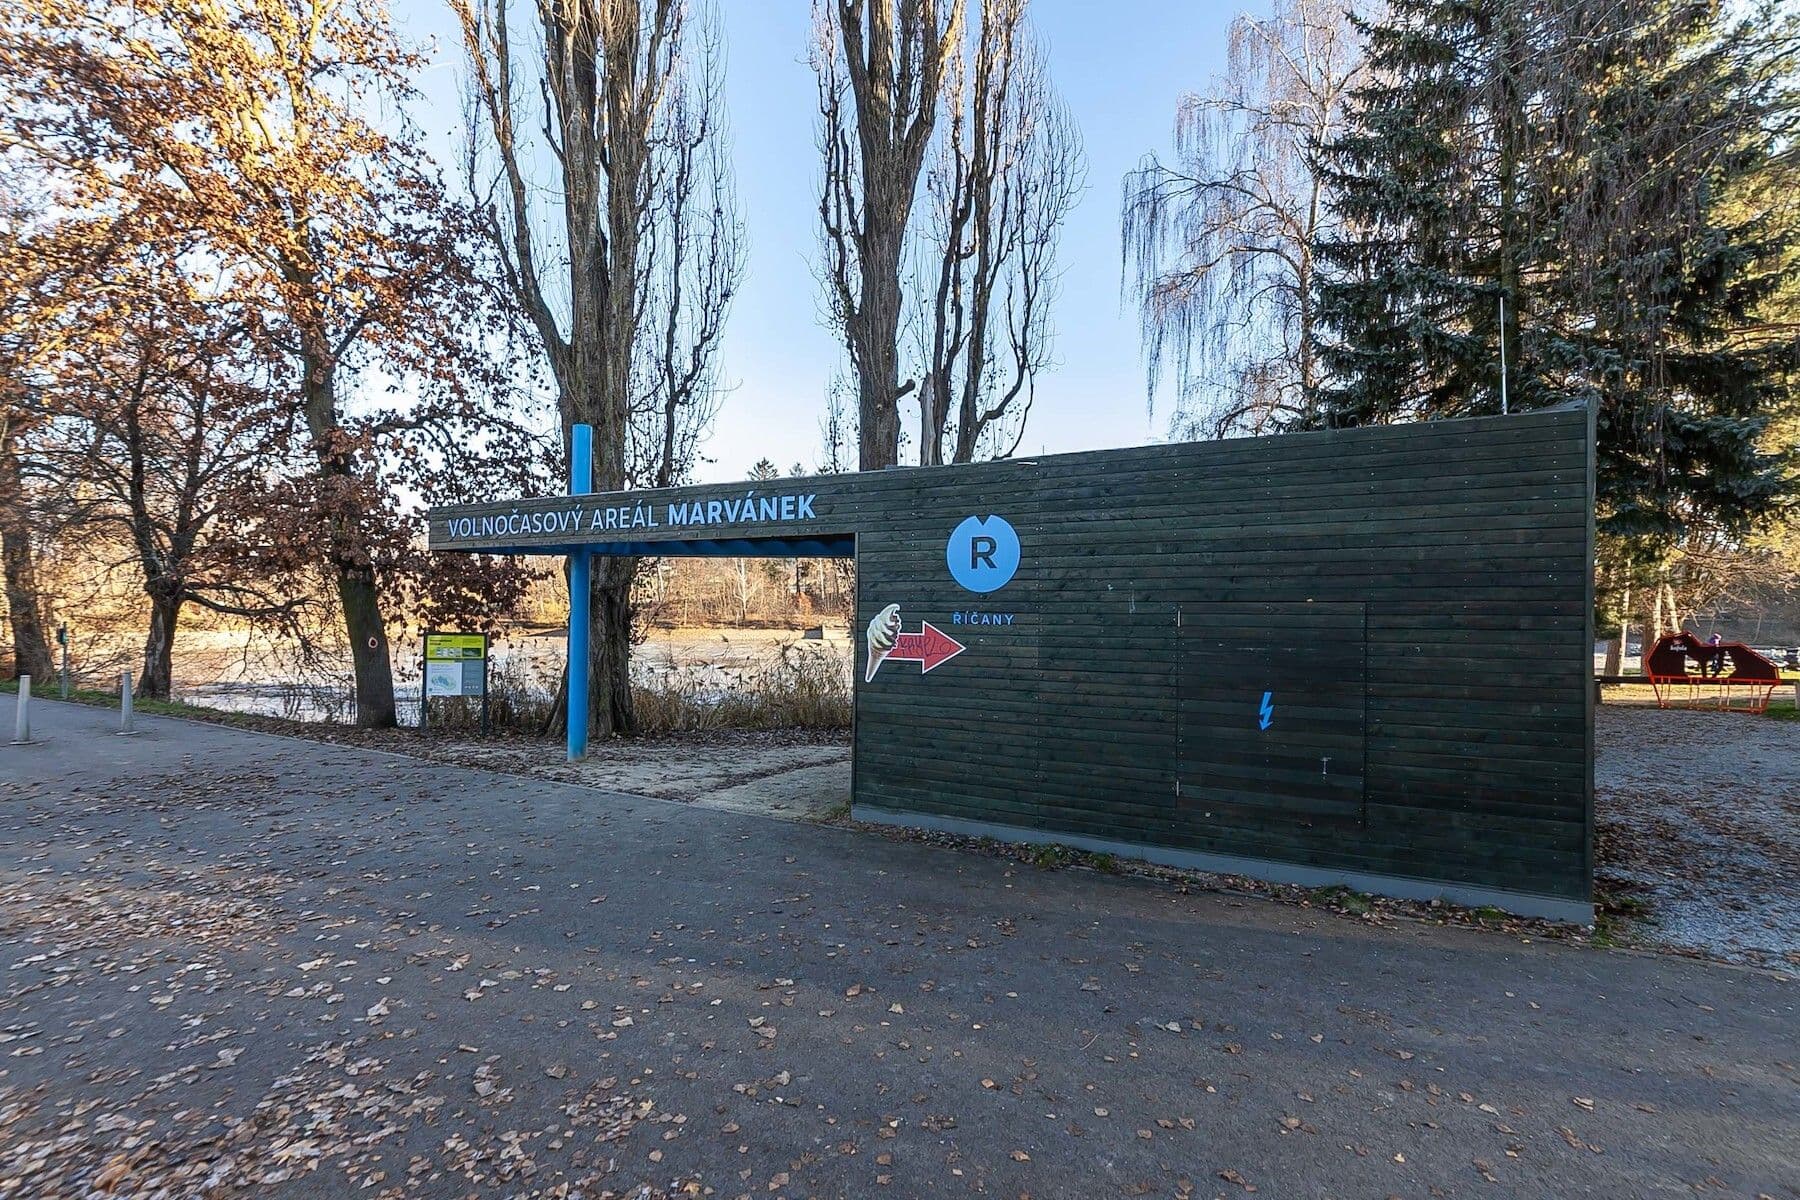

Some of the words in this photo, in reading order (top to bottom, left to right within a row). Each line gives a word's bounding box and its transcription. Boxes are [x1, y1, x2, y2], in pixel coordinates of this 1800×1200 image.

[448, 505, 583, 538] VOLNOČASOVÝ
[591, 499, 659, 530] AREÁL
[668, 491, 817, 525] MARVÁNEK
[970, 536, 998, 570] R
[952, 610, 1015, 625] ŘÍČANY
